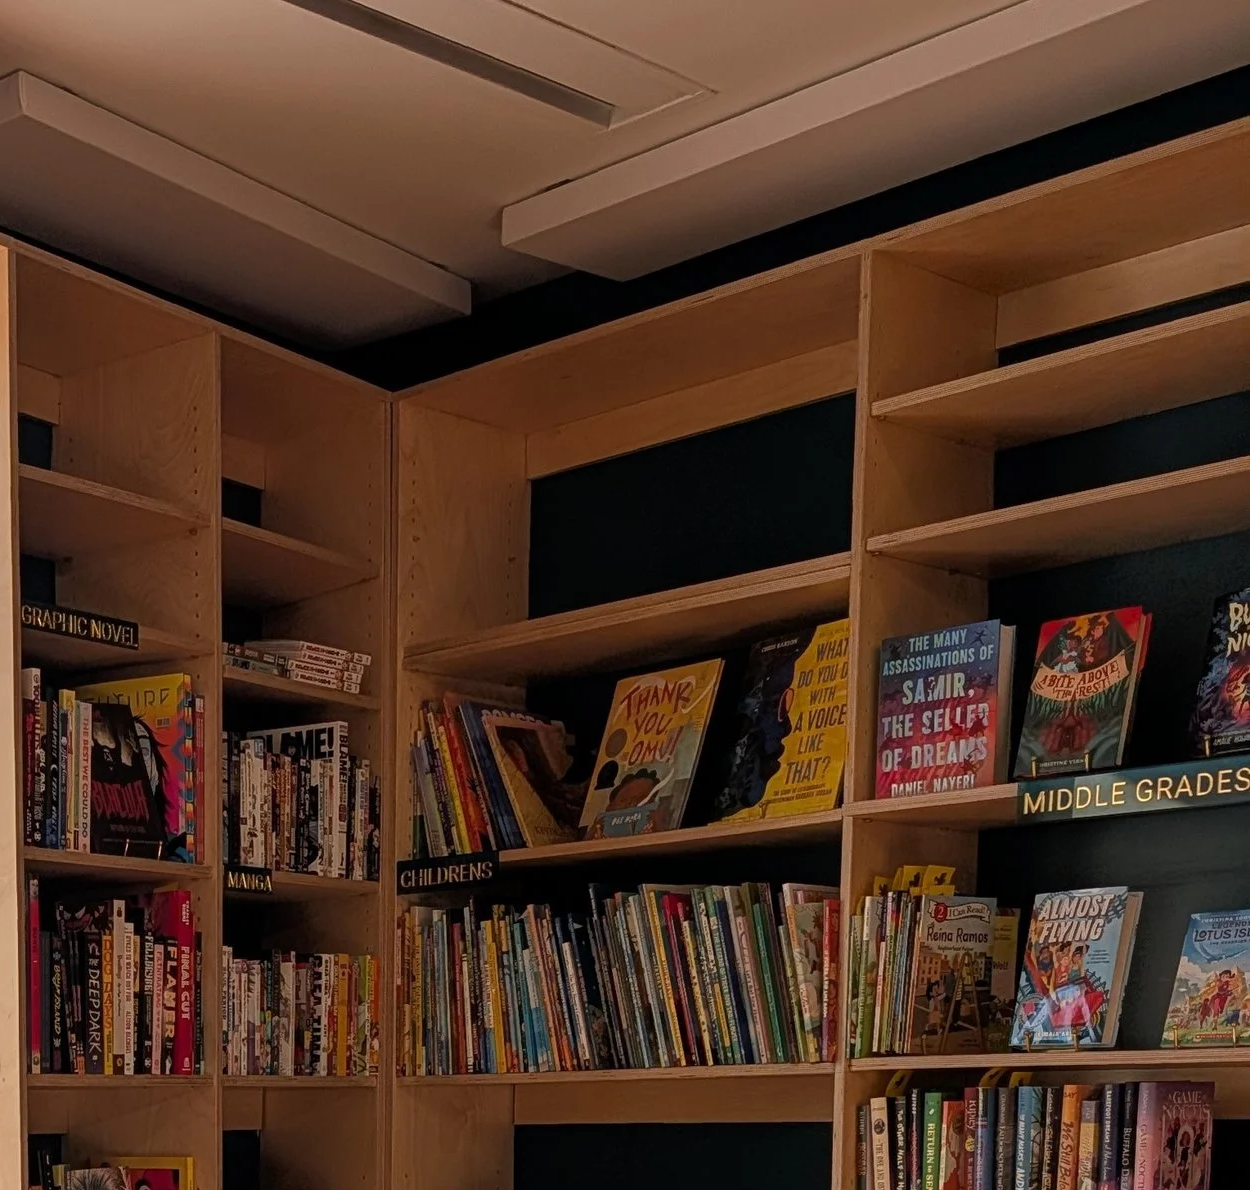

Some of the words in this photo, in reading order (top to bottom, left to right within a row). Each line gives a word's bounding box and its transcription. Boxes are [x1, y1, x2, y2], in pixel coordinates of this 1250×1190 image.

[22, 604, 88, 636] GRAPHIC
[89, 618, 138, 648] NOVEL
[816, 637, 849, 662] WHAT
[908, 637, 930, 653] THE
[933, 629, 968, 647] MANY
[882, 648, 975, 676] ASSASSINATIONS
[979, 645, 994, 660] OF
[1077, 660, 1119, 686] ABOVE
[799, 670, 812, 687] DO
[817, 665, 836, 683] YOU
[901, 673, 975, 705] SAMIR,
[621, 680, 691, 720] THANK
[809, 690, 835, 706] WITH
[634, 711, 672, 741] YOU,
[793, 714, 801, 733] A
[807, 704, 847, 729] VOICE
[882, 713, 915, 739] THE
[921, 703, 990, 735] SELLER
[628, 725, 685, 766] OMU!
[797, 732, 826, 755] LIKE
[881, 747, 903, 773] OF
[911, 737, 987, 769] DREAMS
[784, 756, 831, 785] THAT?
[890, 780, 927, 798] DANIEL
[933, 774, 975, 793] NAYERI
[1023, 781, 1127, 815] MIDDLE
[1136, 766, 1250, 801] GRADES
[228, 871, 272, 894] MANGA
[399, 861, 493, 889] CHILDRENS
[1039, 894, 1115, 922] ALMOST
[927, 927, 953, 942] Reina
[956, 928, 989, 943] Ramos
[1039, 918, 1105, 944] FLYING
[1194, 929, 1232, 942] LOTUS
[181, 946, 191, 987] FINAL
[89, 968, 100, 1012] DEEP
[164, 946, 178, 1037] FLAMER
[103, 982, 112, 1029] DAYS
[181, 991, 191, 1020] CUT
[89, 1012, 103, 1054] DARK
[1172, 1091, 1202, 1104] GAME
[927, 1124, 935, 1164] RETURN
[1122, 1127, 1132, 1166] BUFFALO
